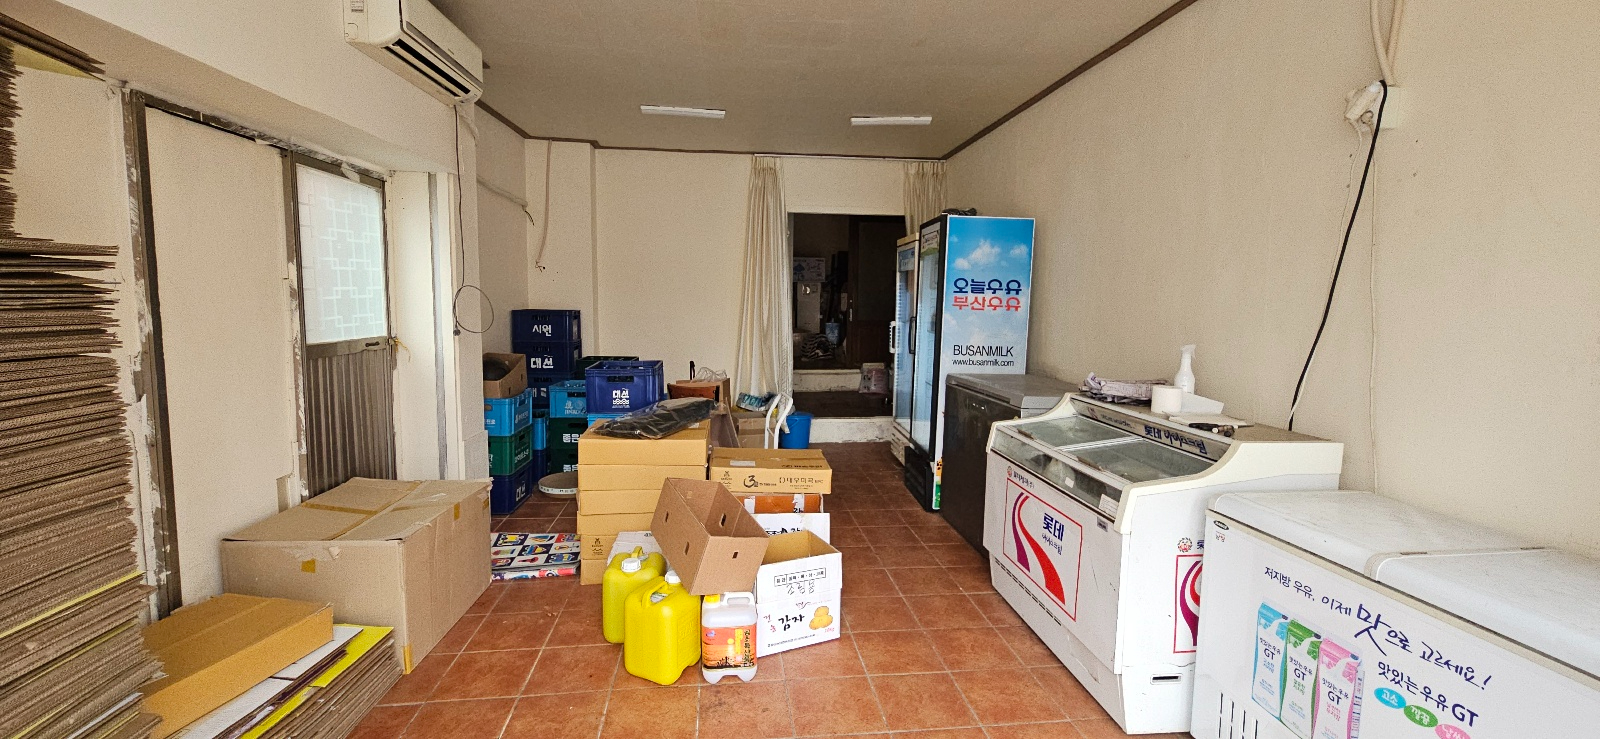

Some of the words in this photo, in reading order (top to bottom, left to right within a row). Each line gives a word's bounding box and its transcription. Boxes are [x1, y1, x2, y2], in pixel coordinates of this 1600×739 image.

[953, 277, 1022, 295] 오늘우유
[952, 295, 1021, 312] 부산우유
[532, 324, 552, 336] 시원
[953, 344, 1014, 357] BUSANMILK
[530, 355, 553, 368] 대선
[952, 358, 1014, 366] www.busanmilk.com
[612, 388, 630, 399] 대선
[562, 434, 580, 443] 좋은
[1144, 425, 1162, 440] 롯데
[1163, 430, 1208, 455] 아이스크림
[1043, 512, 1064, 542] 롯데
[1264, 566, 1292, 588] 저지방
[1321, 596, 1352, 616] 이제
[778, 614, 805, 632] 감자
[1264, 648, 1276, 660] GT
[1294, 668, 1307, 681] GT
[1328, 690, 1342, 705] GT
[1382, 689, 1398, 706] 고소
[1452, 703, 1479, 727] GT
